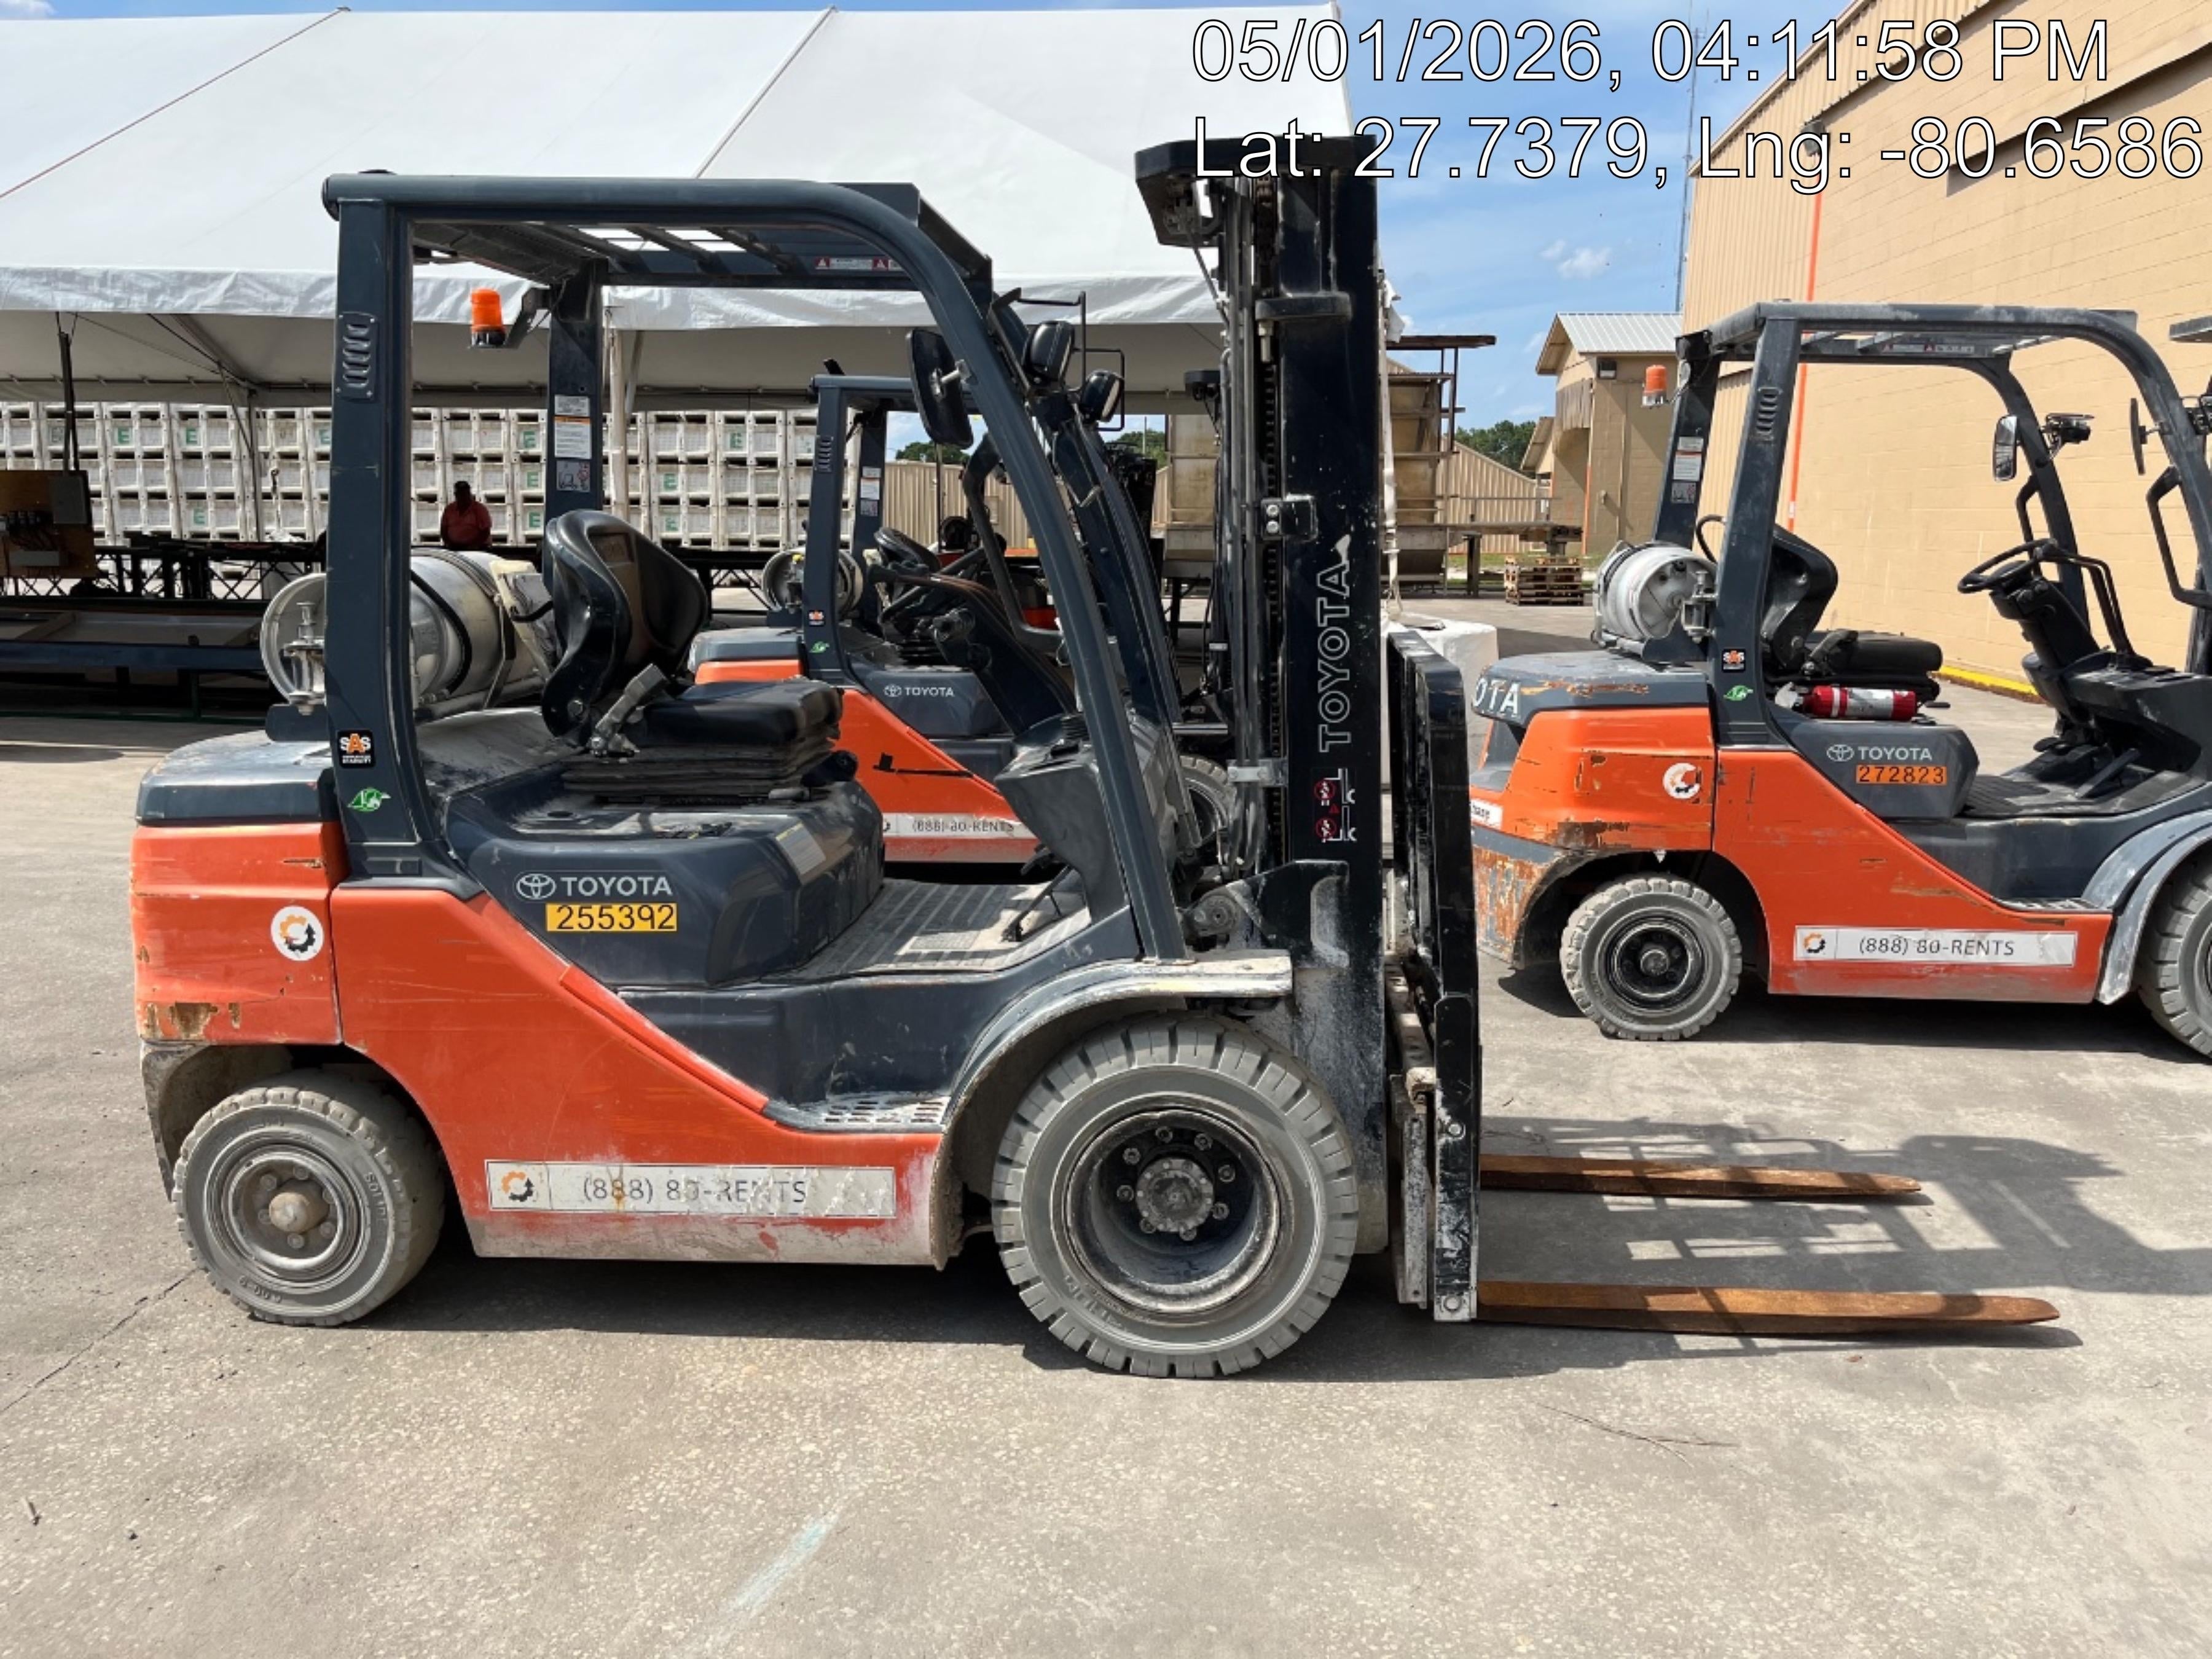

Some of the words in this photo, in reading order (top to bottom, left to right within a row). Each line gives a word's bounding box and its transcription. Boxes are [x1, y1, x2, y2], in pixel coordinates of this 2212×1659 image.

[117, 428, 130, 444] E
[186, 428, 198, 444] E
[527, 472, 539, 487] E
[529, 512, 541, 527] E
[1316, 560, 1351, 752] TOYOTA
[905, 686, 955, 697] TOYOTA
[340, 733, 371, 753] SAS
[1857, 746, 1932, 761] TOYOTA
[1859, 766, 1944, 784] 272823
[560, 876, 673, 896] TOYOTA
[556, 904, 675, 930] 255392
[1859, 935, 1908, 957] (888)
[1916, 938, 2014, 956] 80-RENTS
[584, 1177, 653, 1204] (888)
